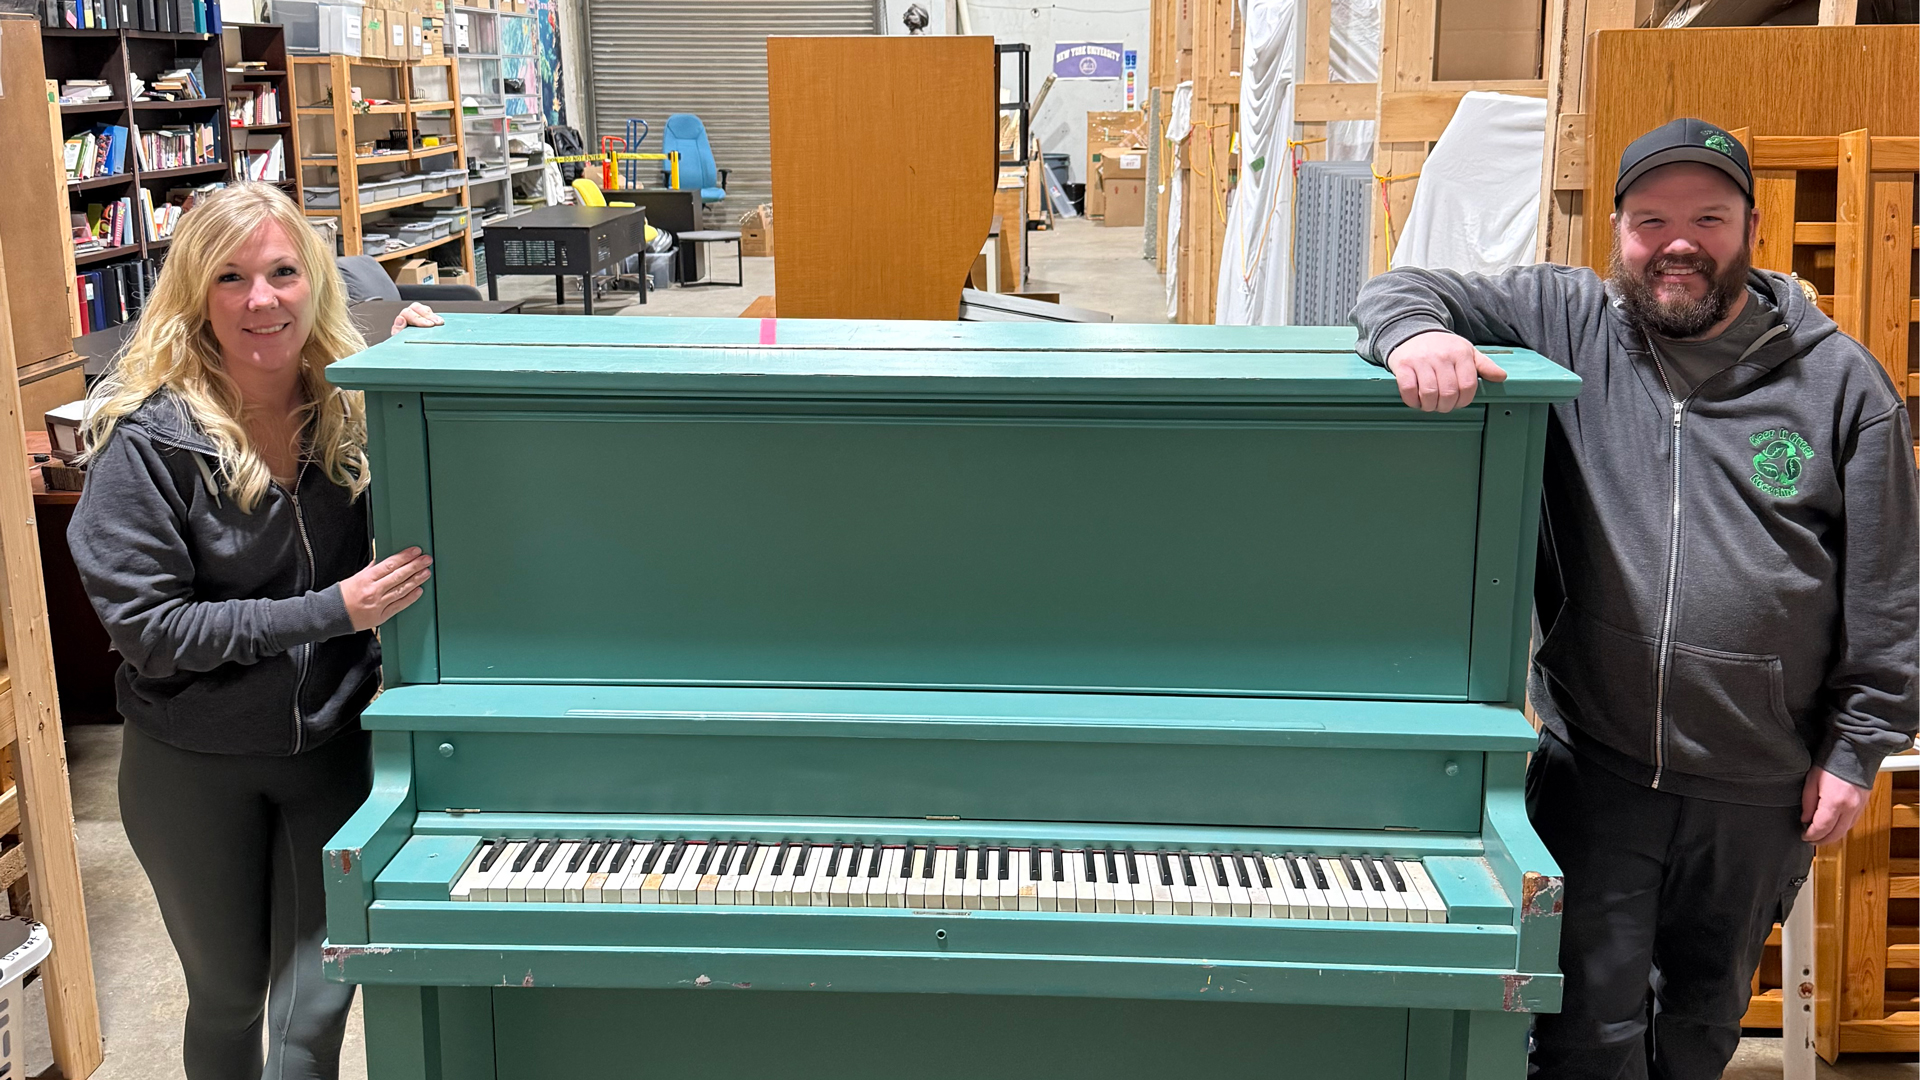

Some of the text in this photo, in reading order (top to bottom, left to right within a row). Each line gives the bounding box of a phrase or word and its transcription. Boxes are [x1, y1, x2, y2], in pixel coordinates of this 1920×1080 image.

[1056, 45, 1120, 63] NEW YORK UNIVERSITY
[1749, 429, 1776, 447] Keep
[1788, 432, 1815, 460] Green
[1749, 473, 1799, 498] Recycling
